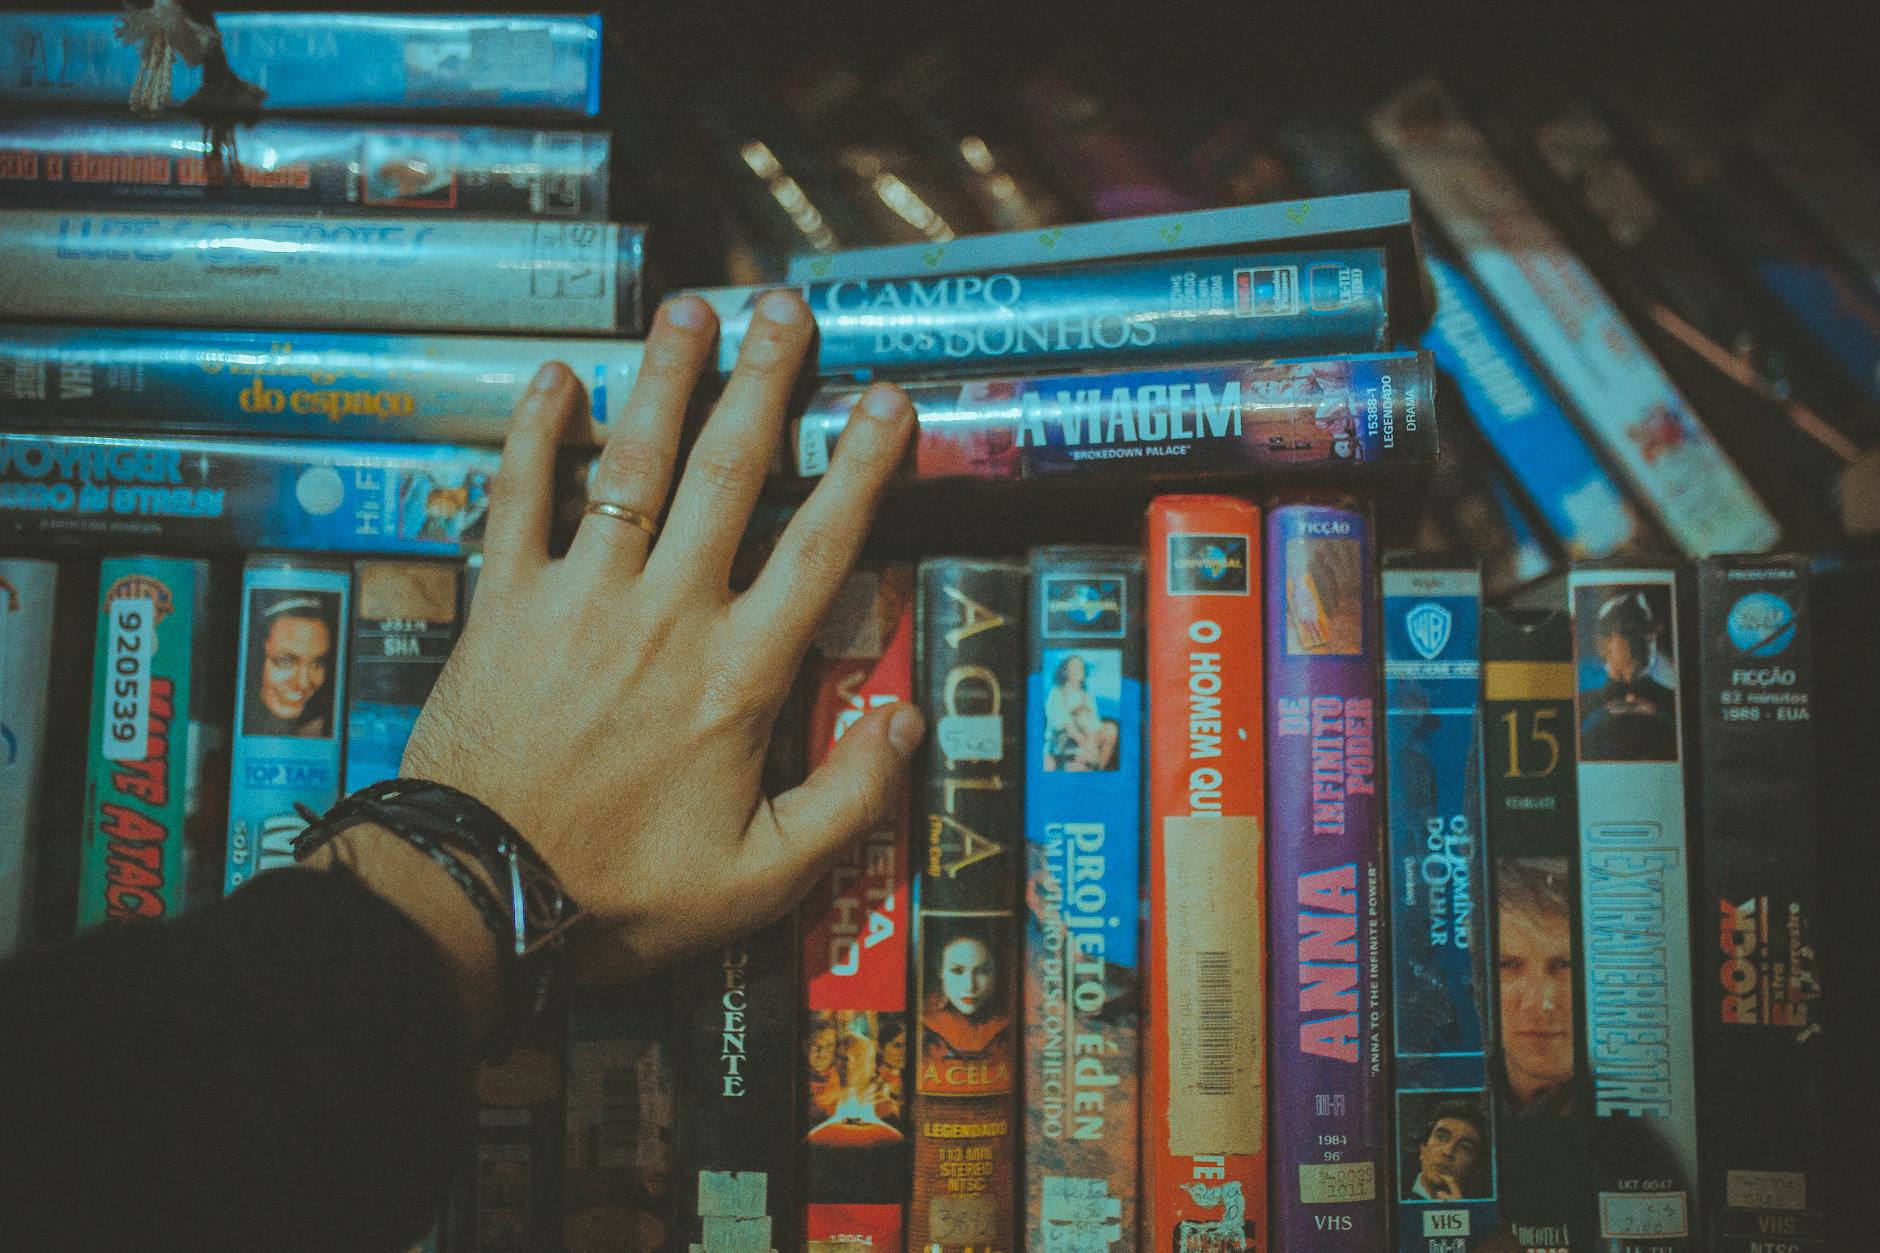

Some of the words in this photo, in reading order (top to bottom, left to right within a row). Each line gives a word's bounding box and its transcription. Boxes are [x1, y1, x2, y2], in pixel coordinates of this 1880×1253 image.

[827, 274, 1021, 315] CAMPO
[945, 315, 1157, 358] SONHOS
[239, 378, 285, 413] do
[290, 388, 416, 422] espaço
[1015, 395, 1048, 448] A
[1058, 381, 1242, 443] VIAGEM
[1367, 387, 1378, 437] 15388-1
[1381, 375, 1394, 449] LEGENDADO
[1405, 388, 1416, 432] DRAMA
[1300, 520, 1350, 537] FICÇÃO
[1188, 619, 1222, 644] O
[112, 611, 142, 743] 920539
[1731, 667, 1796, 687] FICÇÃO
[1188, 652, 1222, 759] HOMEM
[1776, 707, 1810, 721] EUA
[1310, 694, 1345, 836] INFINITO
[1344, 699, 1375, 795] PODER
[1503, 708, 1560, 778] 15
[944, 664, 1005, 878] CLA
[101, 803, 168, 920] ATAC
[1421, 853, 1452, 946] OLHAR
[1297, 862, 1361, 1064] ANNA
[1369, 919, 1380, 978] INFINITE
[1719, 896, 1757, 1025] ROCK
[1369, 981, 1380, 1009] THE
[1370, 1012, 1380, 1030] TO
[944, 1064, 1010, 1086] CELA
[1317, 1134, 1348, 1146] 1984
[1314, 1215, 1353, 1231] VHS
[1431, 1214, 1464, 1230] VHS
[1759, 1215, 1795, 1234] VHS
